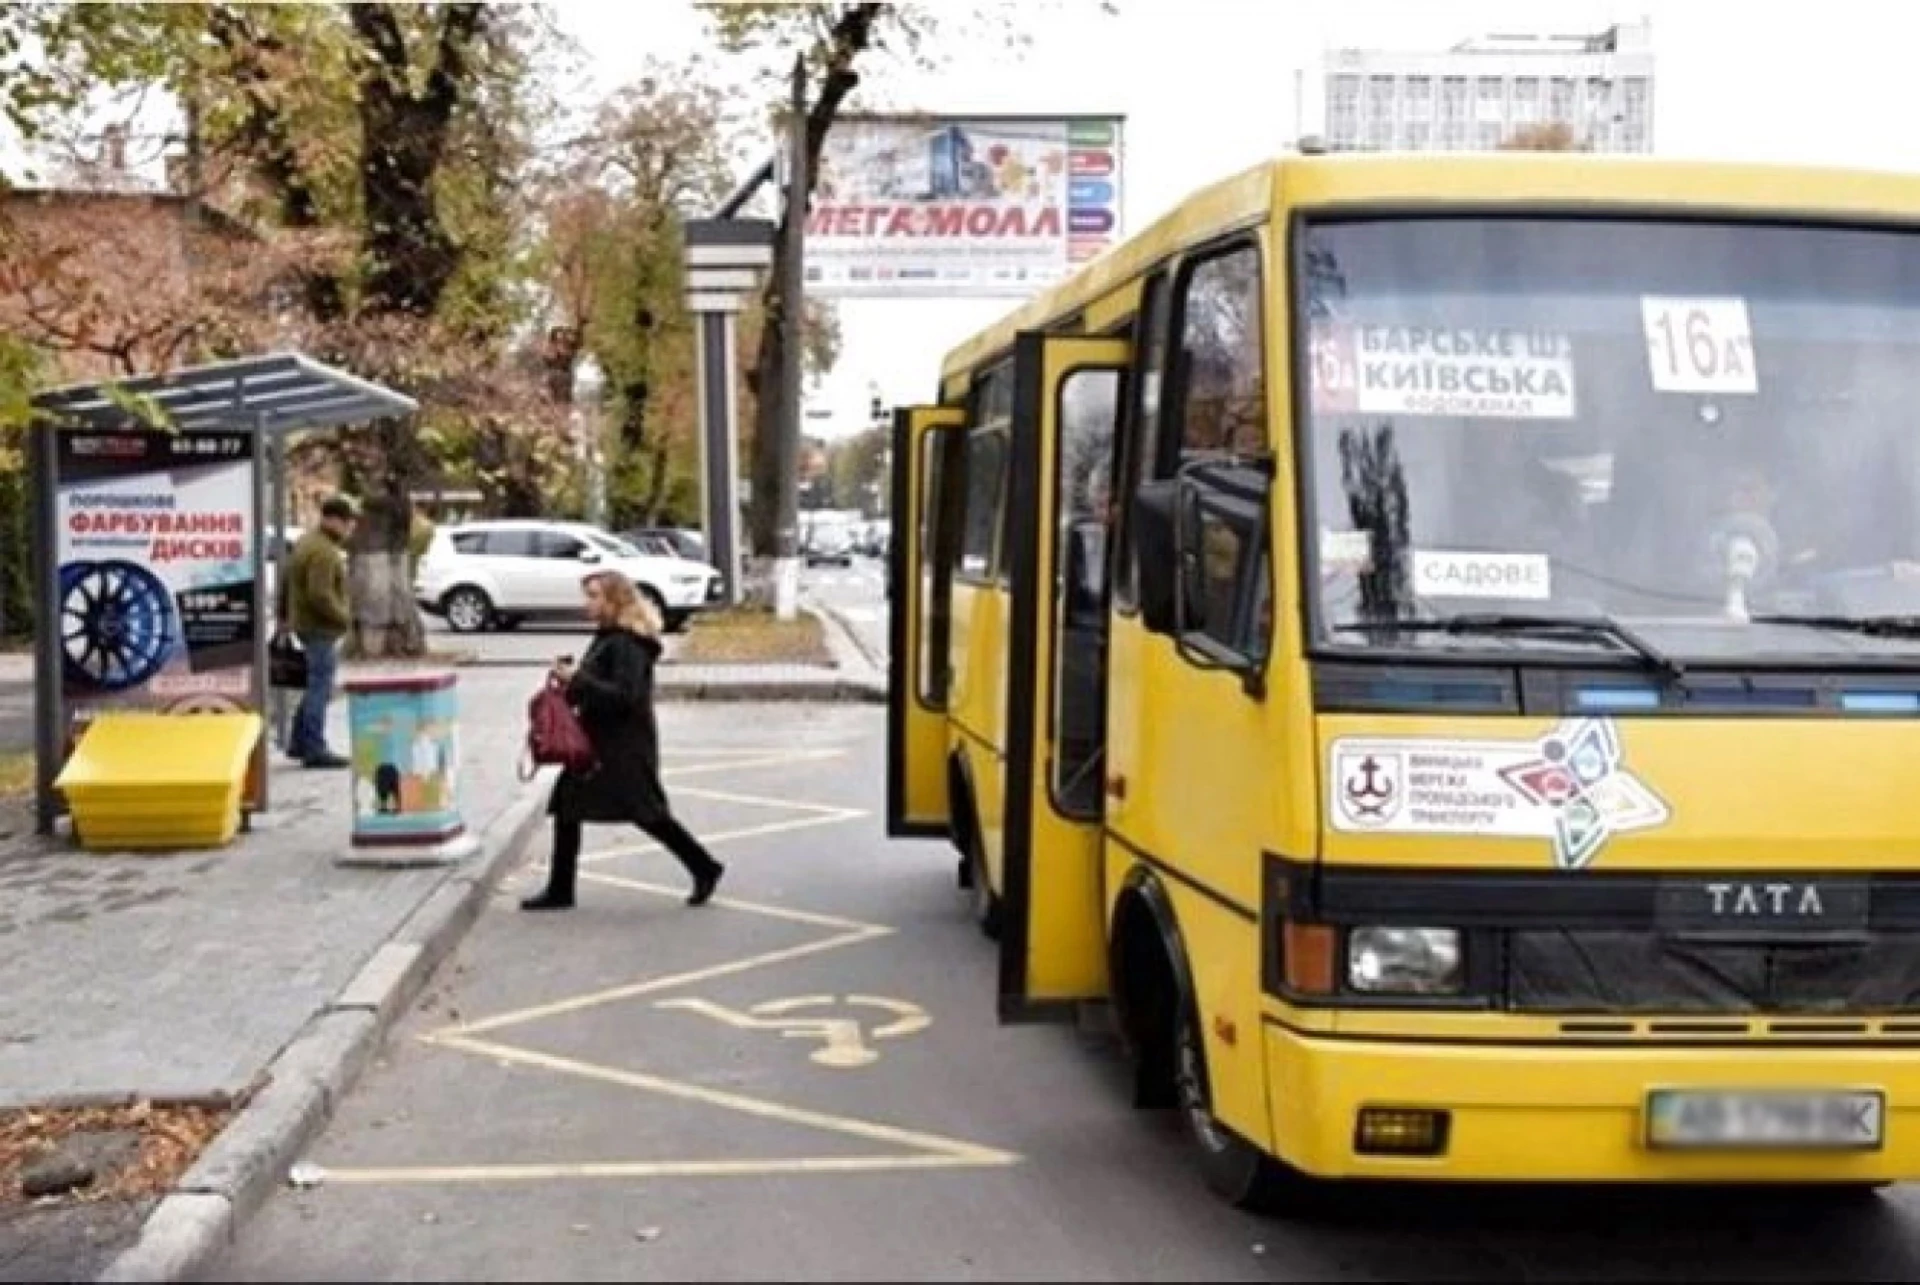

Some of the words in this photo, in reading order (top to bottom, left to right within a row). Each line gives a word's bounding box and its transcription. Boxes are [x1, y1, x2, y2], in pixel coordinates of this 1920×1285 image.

[1361, 325, 1515, 357] БАРСЬКЕ
[1364, 358, 1569, 397] КИЇВСЬКА
[69, 512, 243, 533] ФАРБУВАННЯ
[150, 538, 243, 562] ДИСКІВ
[1423, 561, 1540, 587] САДОВЕ
[1706, 883, 1822, 914] TATA
